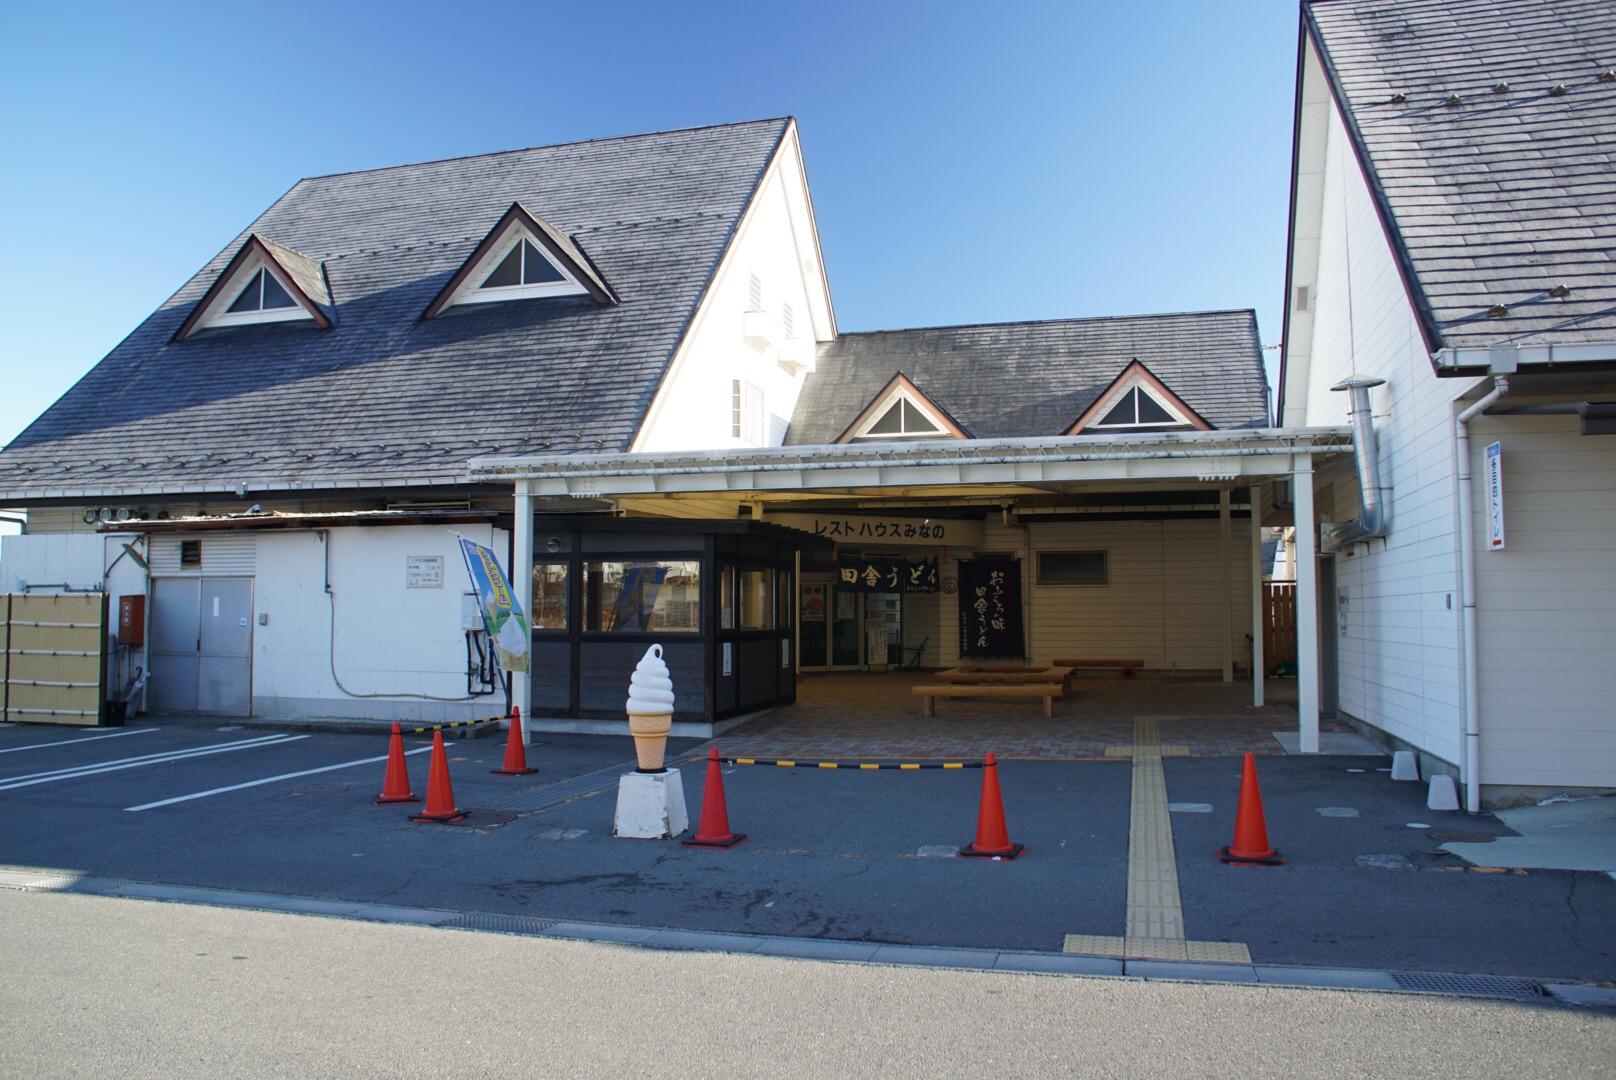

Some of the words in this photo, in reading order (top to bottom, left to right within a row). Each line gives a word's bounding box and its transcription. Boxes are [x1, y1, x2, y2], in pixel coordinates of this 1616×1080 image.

[815, 520, 945, 539] レストハウスみなの
[974, 586, 990, 648] 田舎うどん
[990, 570, 1006, 632] おふくろの味
